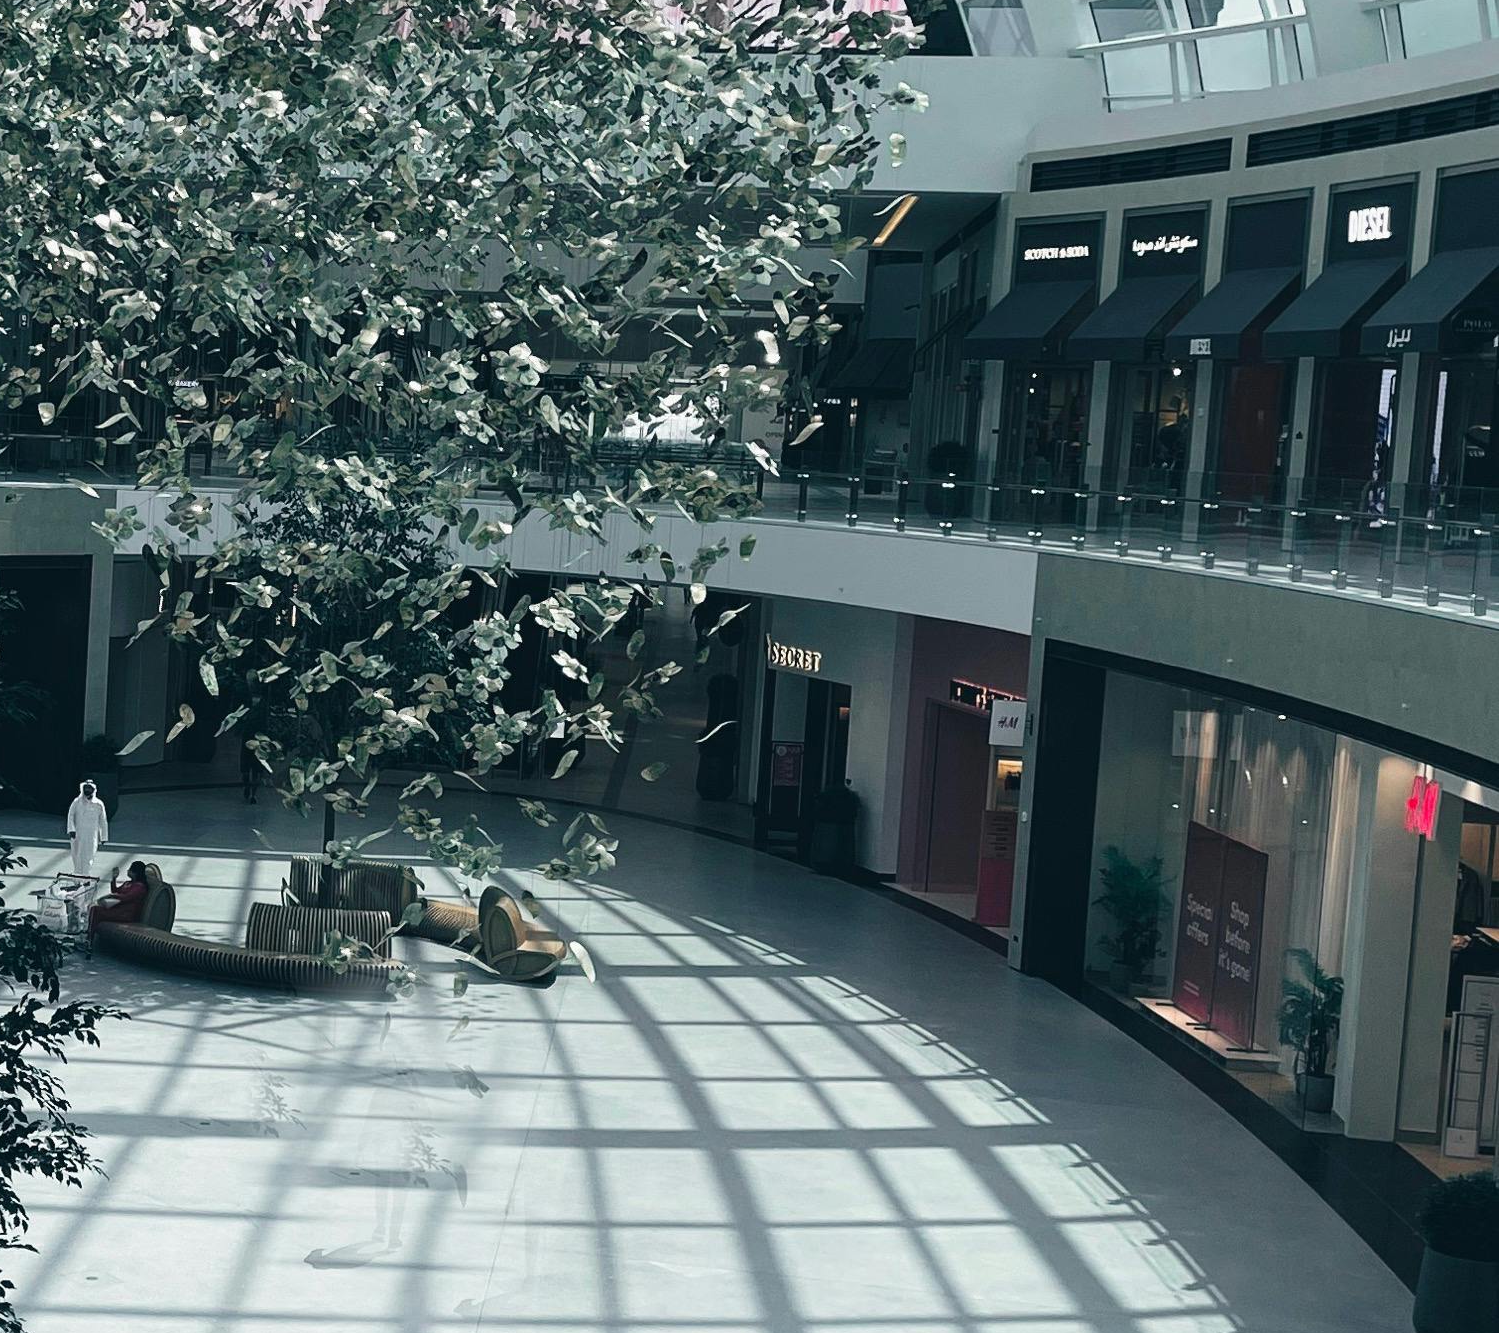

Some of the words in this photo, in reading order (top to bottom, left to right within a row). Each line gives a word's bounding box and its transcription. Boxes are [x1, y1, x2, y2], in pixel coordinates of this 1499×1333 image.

[1347, 206, 1393, 244] DIESEL
[771, 641, 822, 673] SECRET
[1230, 901, 1250, 930] Shop
[1225, 924, 1251, 955] before
